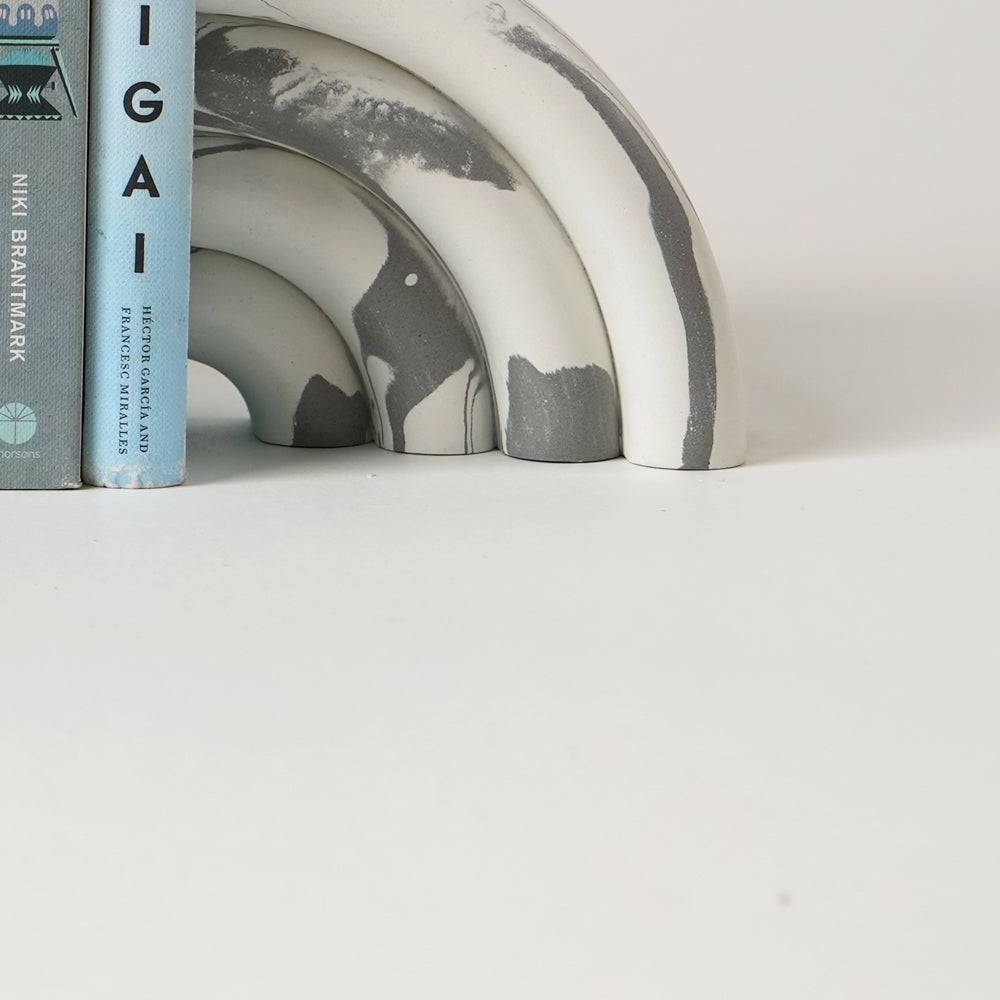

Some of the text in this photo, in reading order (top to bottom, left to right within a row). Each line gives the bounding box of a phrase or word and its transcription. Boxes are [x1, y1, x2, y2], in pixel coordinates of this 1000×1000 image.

[9, 174, 28, 362] NIKI BRANTMARK
[118, 307, 131, 455] FRANCESC MIRALLES
[139, 306, 153, 453] HÉCTOR GARCÍA AND
